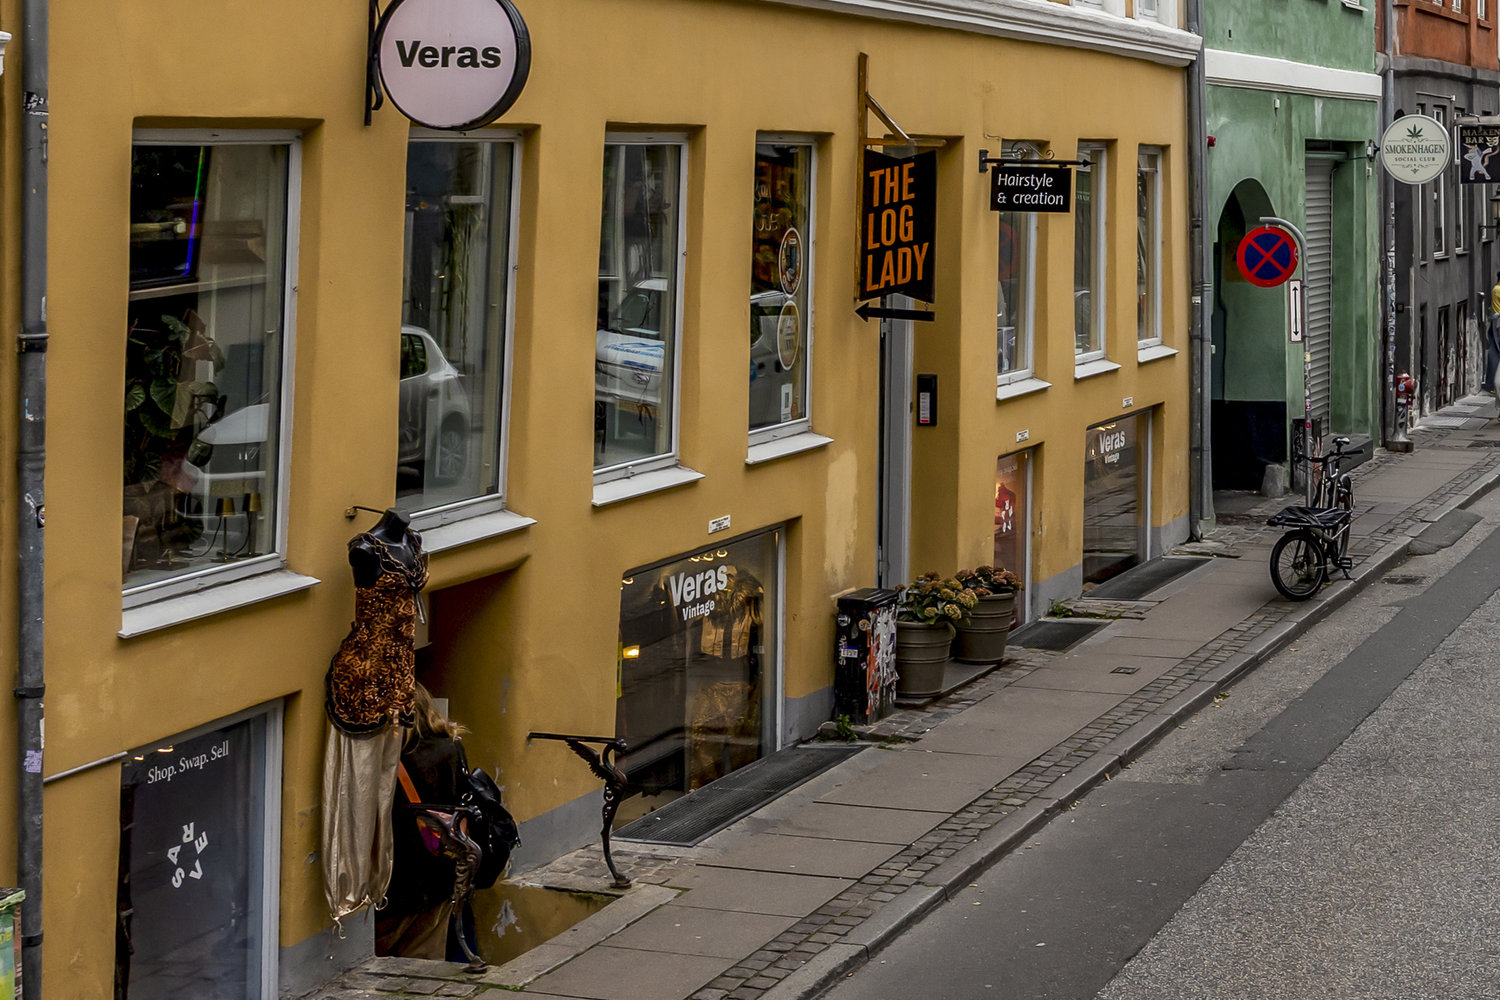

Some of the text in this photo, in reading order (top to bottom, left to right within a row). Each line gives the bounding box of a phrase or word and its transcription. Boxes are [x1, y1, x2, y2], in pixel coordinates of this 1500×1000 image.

[395, 40, 502, 69] Veras
[1385, 144, 1445, 155] SMOKENHAGEN
[1465, 136, 1484, 144] BAR
[869, 162, 915, 207] THE
[997, 173, 1054, 191] Hairstyle
[997, 192, 1007, 204] &
[1012, 192, 1064, 205] creation
[867, 204, 914, 250] LOG
[866, 242, 929, 292] LADY
[1099, 430, 1126, 454] Veras
[670, 565, 728, 607] Veras
[682, 600, 715, 621] Vintage
[147, 740, 230, 784] Shop. Swap. Sell
